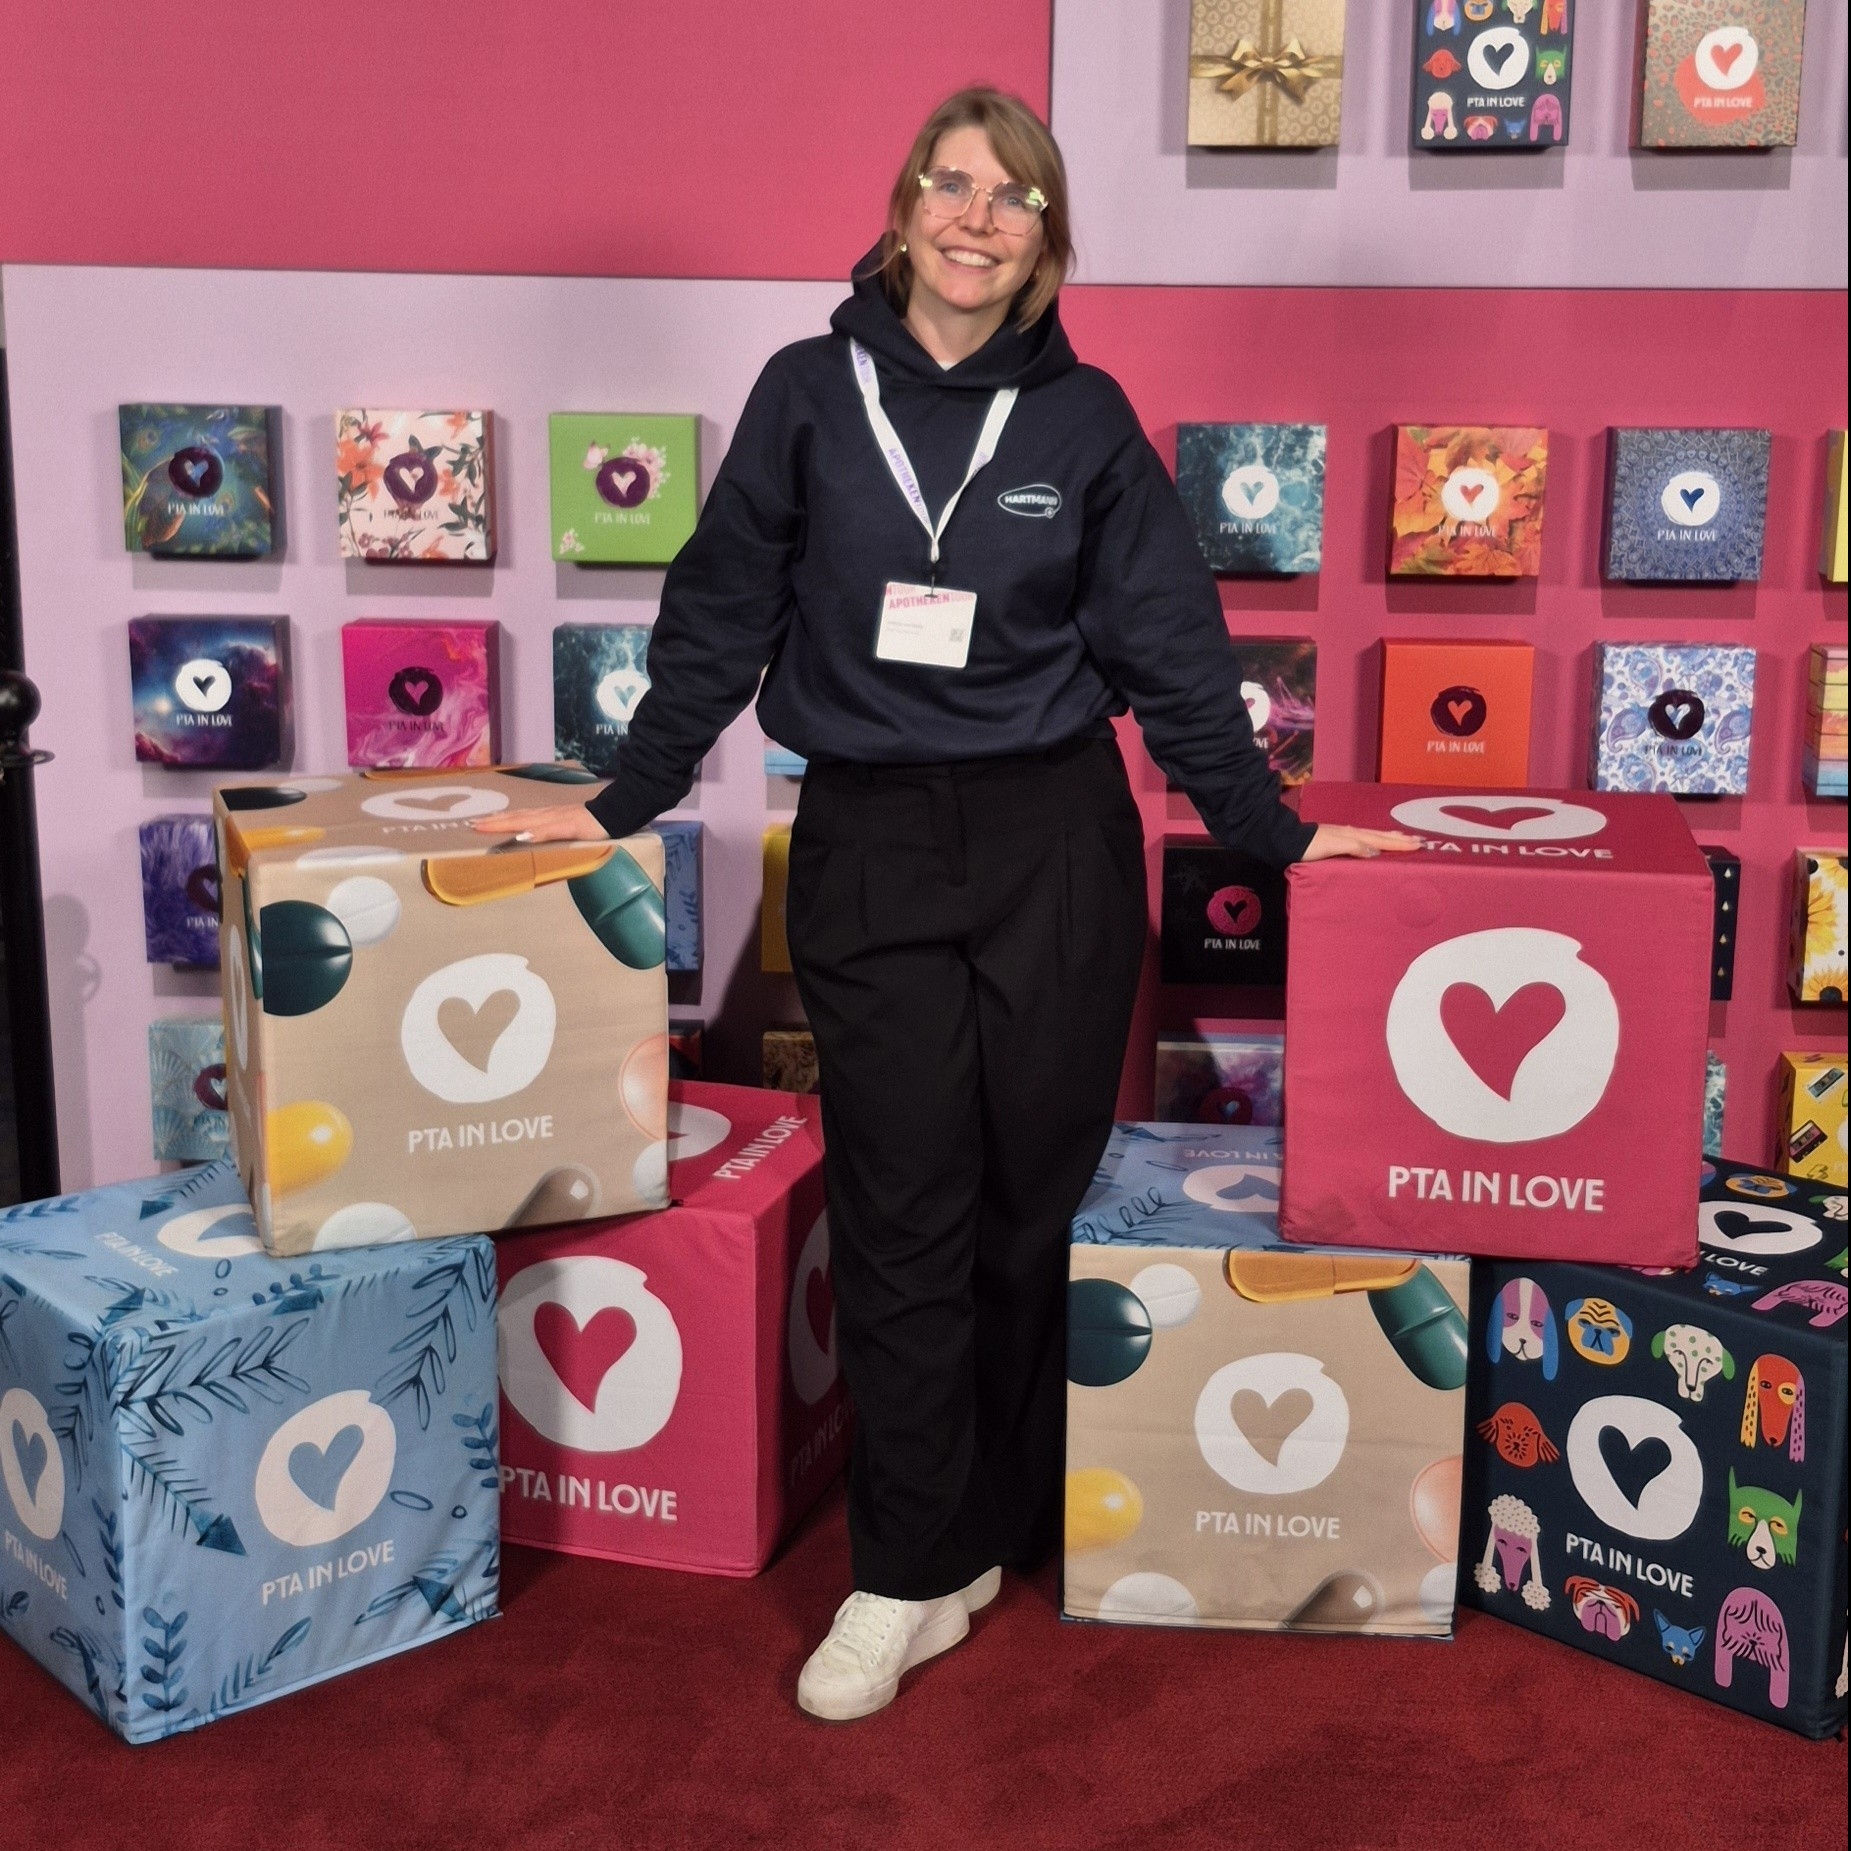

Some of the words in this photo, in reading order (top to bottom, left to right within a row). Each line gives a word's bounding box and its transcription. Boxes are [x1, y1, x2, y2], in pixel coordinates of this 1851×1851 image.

[1467, 97, 1484, 108] PTA
[1486, 96, 1497, 107] IN
[1499, 96, 1525, 108] LOVE
[1693, 97, 1712, 108] PTA
[1713, 97, 1725, 108] IN
[1726, 97, 1753, 108] LOVE
[188, 502, 201, 515] IN
[616, 512, 627, 524] IN
[1241, 522, 1253, 534] IN
[1657, 528, 1676, 541] PTA
[1680, 529, 1692, 541] IN
[197, 714, 209, 726] IN
[1449, 741, 1461, 753] IN
[1424, 840, 1462, 852] TA
[1471, 843, 1509, 855] IN
[1519, 845, 1614, 859] LOVE
[1204, 938, 1222, 949] PTA
[1225, 938, 1236, 950] IN
[1239, 938, 1260, 950] LOVE
[408, 1127, 454, 1153] PTA
[458, 1122, 485, 1147] IN
[491, 1114, 554, 1144] LOVE
[753, 1115, 808, 1144] LOVE
[738, 1143, 776, 1158] IN
[1184, 1149, 1239, 1159] LOVE
[712, 1158, 761, 1180] PTA
[1388, 1165, 1454, 1201] PTA
[1461, 1170, 1500, 1204] IN
[1509, 1173, 1605, 1212] LOVE
[131, 1253, 179, 1277] LOVE
[1704, 1253, 1769, 1276] LOVE
[499, 1465, 552, 1501] PTA
[559, 1474, 591, 1508] IN
[599, 1480, 678, 1521] LOVE
[1196, 1510, 1241, 1534] PTA
[1245, 1513, 1272, 1537] IN
[1277, 1514, 1341, 1540] LOVE
[5, 1530, 25, 1566] PTA
[25, 1547, 38, 1576] IN
[39, 1557, 67, 1600] LOVE
[262, 1571, 304, 1606] PTA
[308, 1561, 333, 1589] IN
[338, 1539, 395, 1579] LOVE
[1566, 1532, 1605, 1566] PTA
[1608, 1547, 1632, 1576] IN
[1636, 1558, 1694, 1599] LOVE
